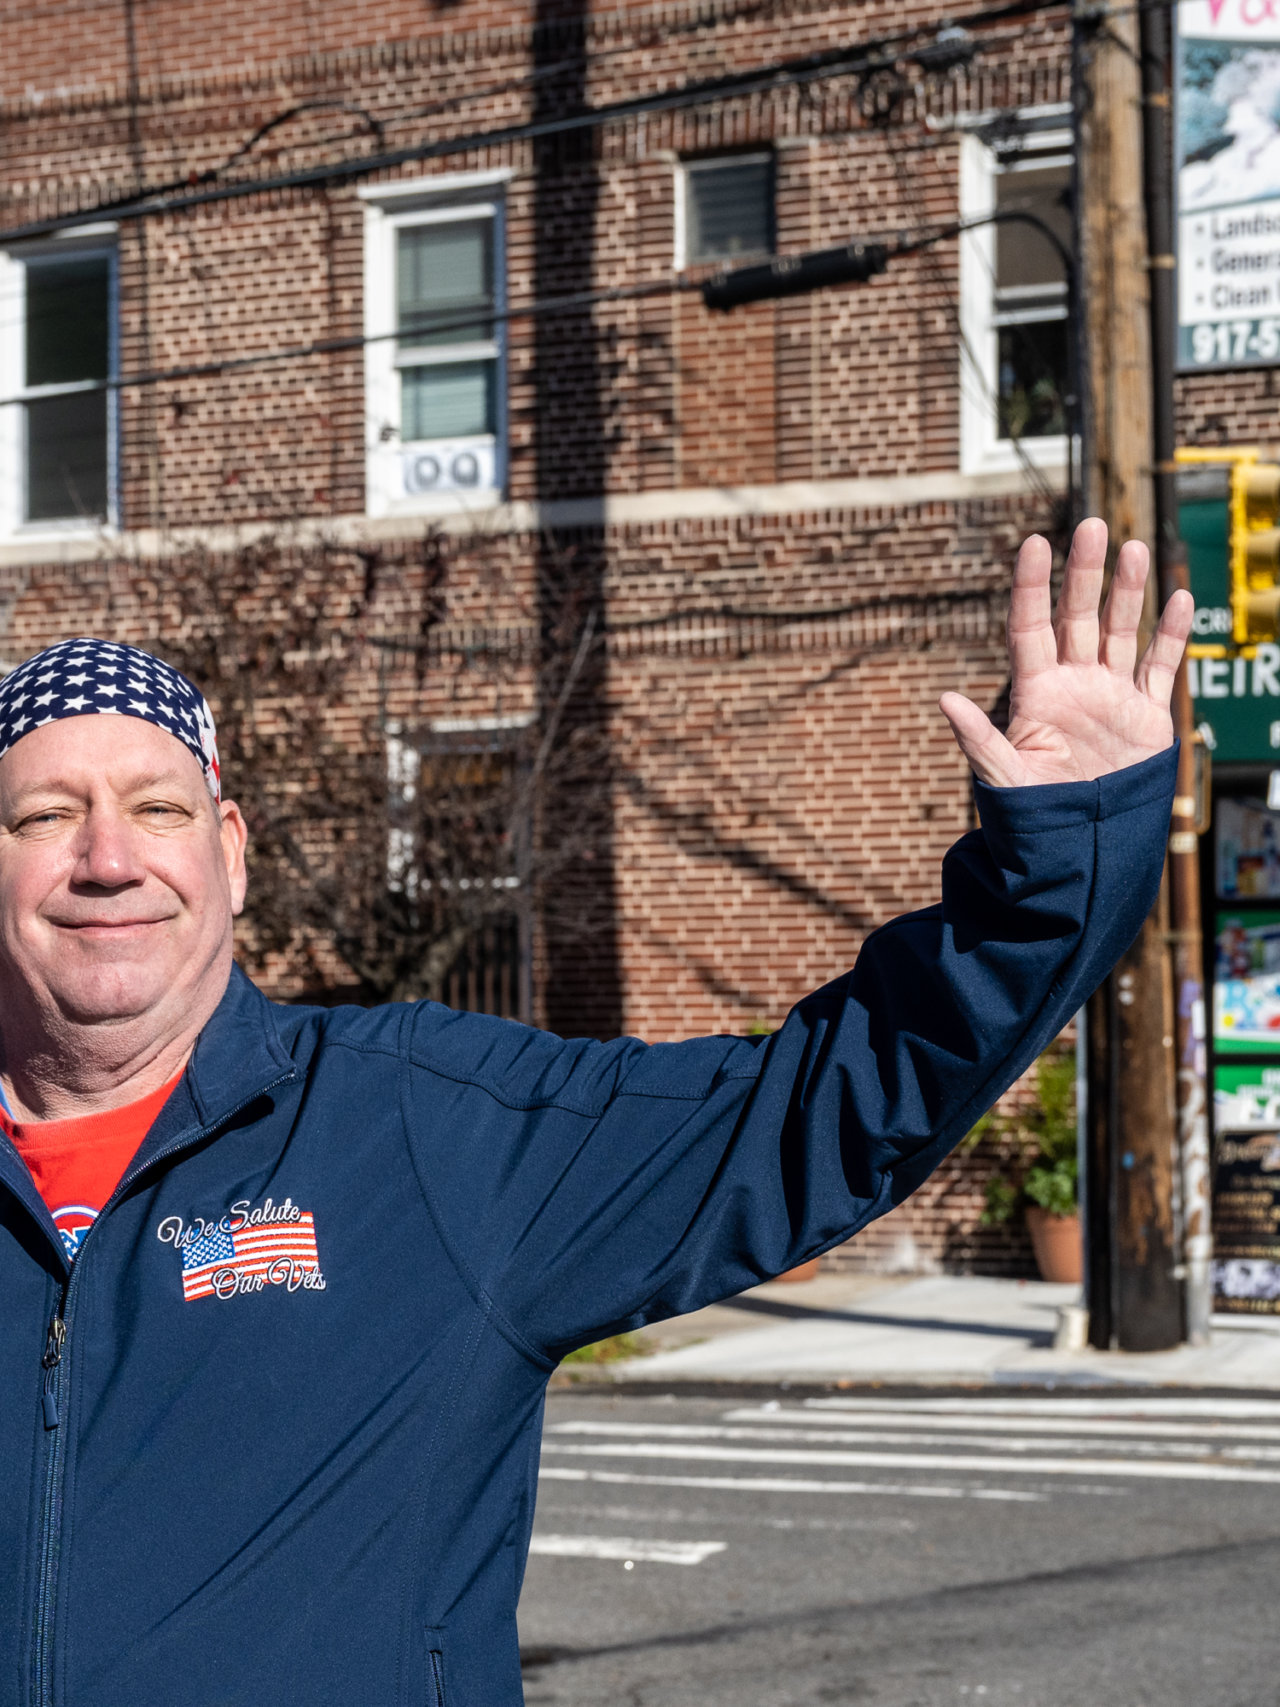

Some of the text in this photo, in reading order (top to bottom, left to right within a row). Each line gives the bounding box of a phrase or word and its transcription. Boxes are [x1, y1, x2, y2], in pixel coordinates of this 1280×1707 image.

[157, 1198, 301, 1248] We Salute
[212, 1257, 327, 1300] Our Vets
